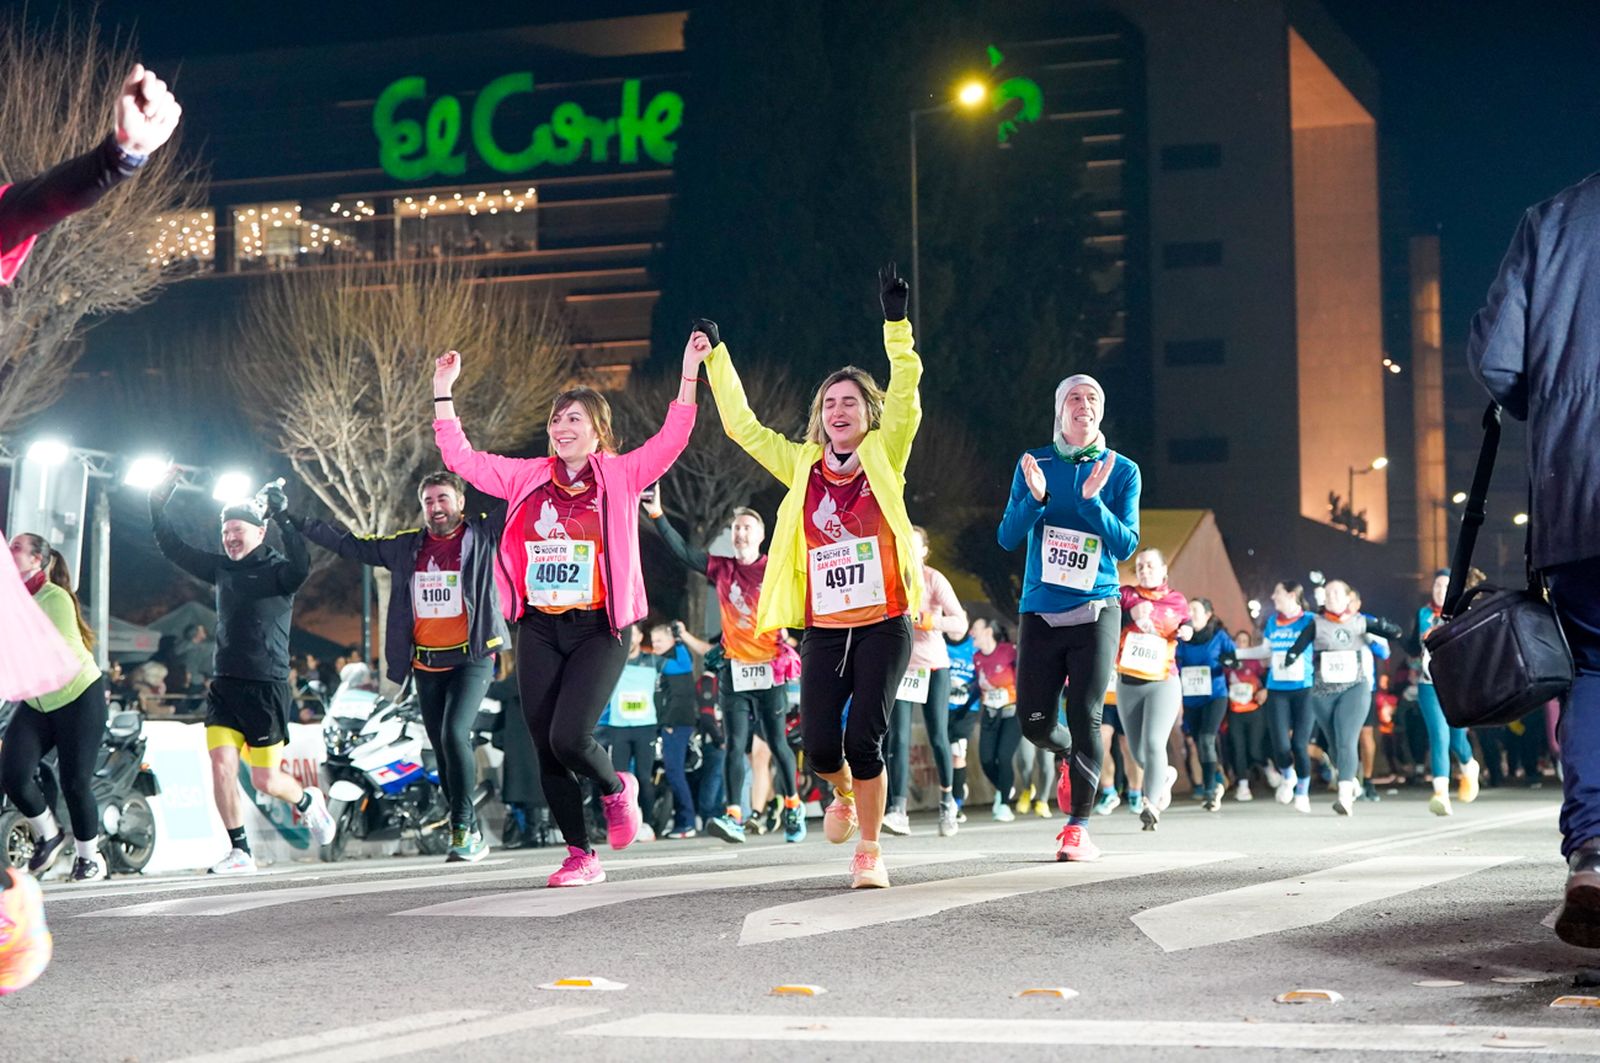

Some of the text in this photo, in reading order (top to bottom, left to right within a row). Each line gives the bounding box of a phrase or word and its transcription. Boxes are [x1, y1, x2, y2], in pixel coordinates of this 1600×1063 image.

[372, 71, 684, 181] El Corte
[824, 519, 842, 538] 43
[1048, 547, 1089, 570] 3599
[536, 563, 580, 583] 4062
[825, 563, 865, 589] 4977
[422, 588, 451, 602] 4100
[742, 666, 766, 678] 5779
[279, 758, 321, 788] SAN
